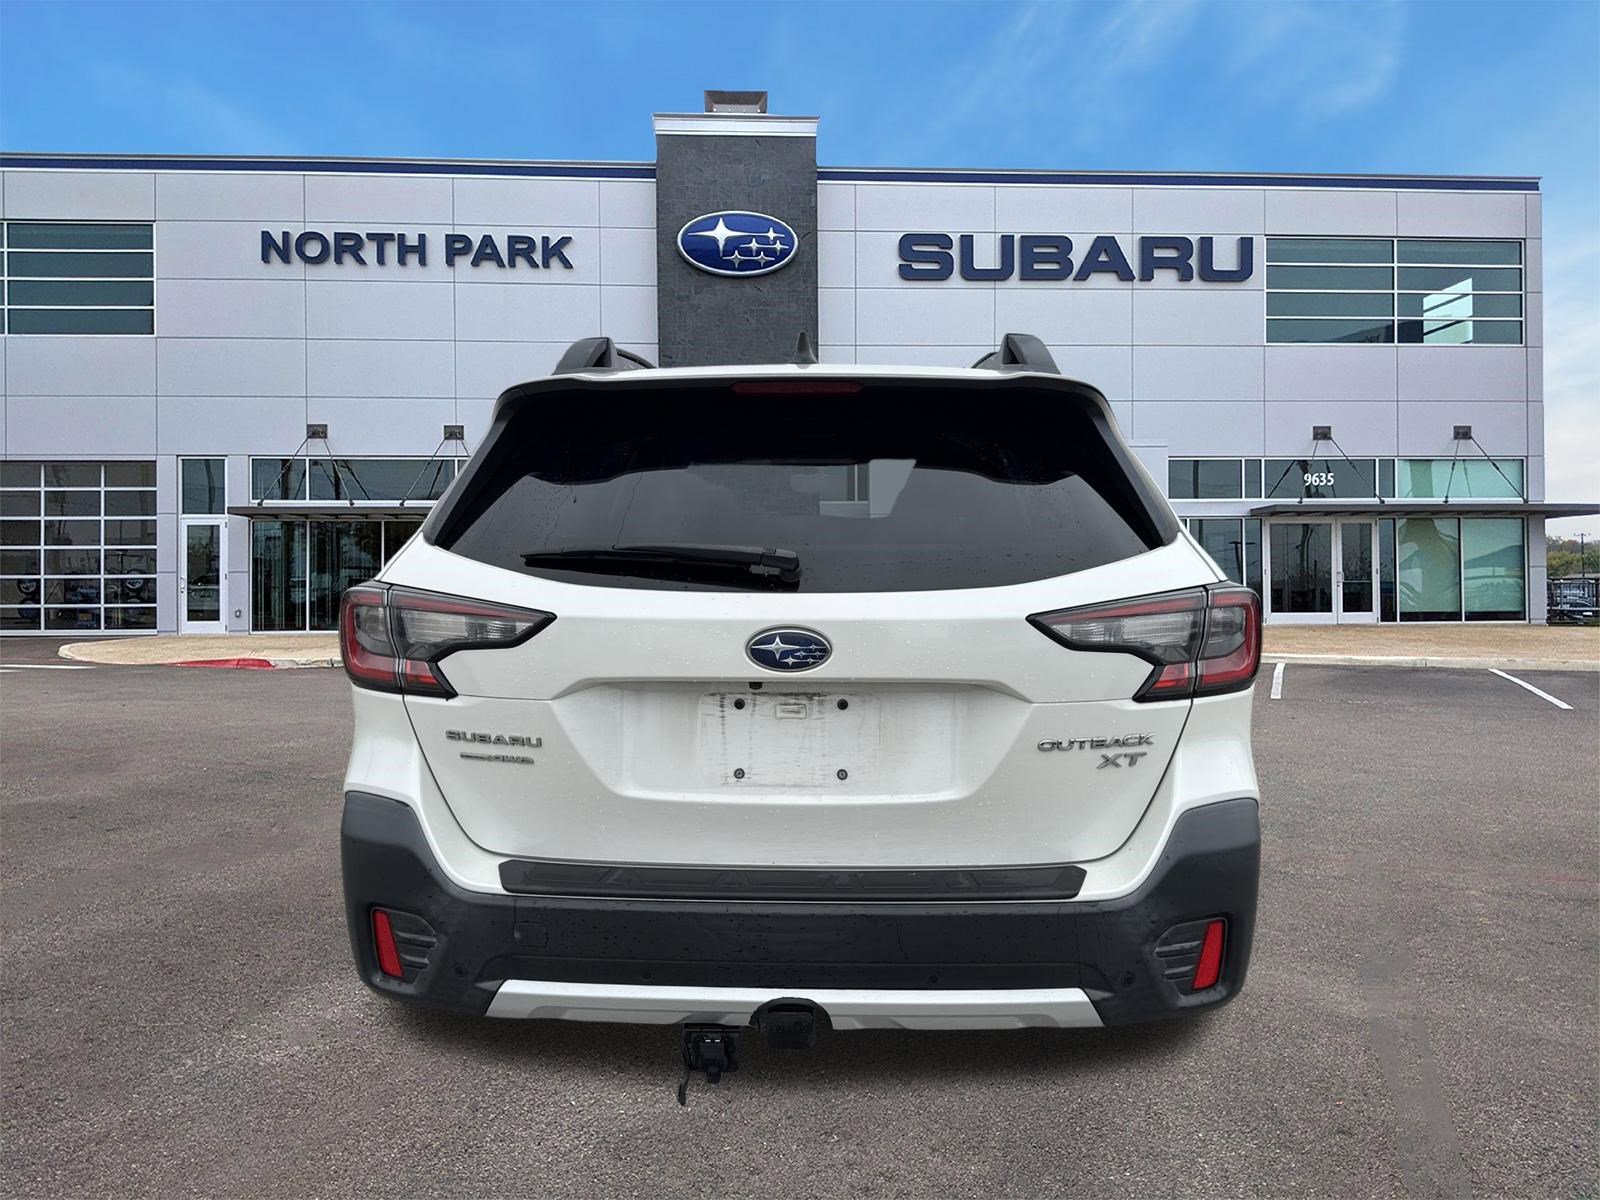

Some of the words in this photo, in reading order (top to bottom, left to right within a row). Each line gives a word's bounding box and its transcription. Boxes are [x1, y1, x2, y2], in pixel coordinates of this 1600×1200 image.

[261, 230, 427, 266] NORTH
[445, 234, 574, 269] PARK
[899, 233, 1254, 282] SUBARU
[1303, 472, 1335, 486] 9635
[445, 729, 543, 748] SUBARU
[1037, 731, 1155, 752] OUTBACK
[1096, 751, 1148, 769] XT
